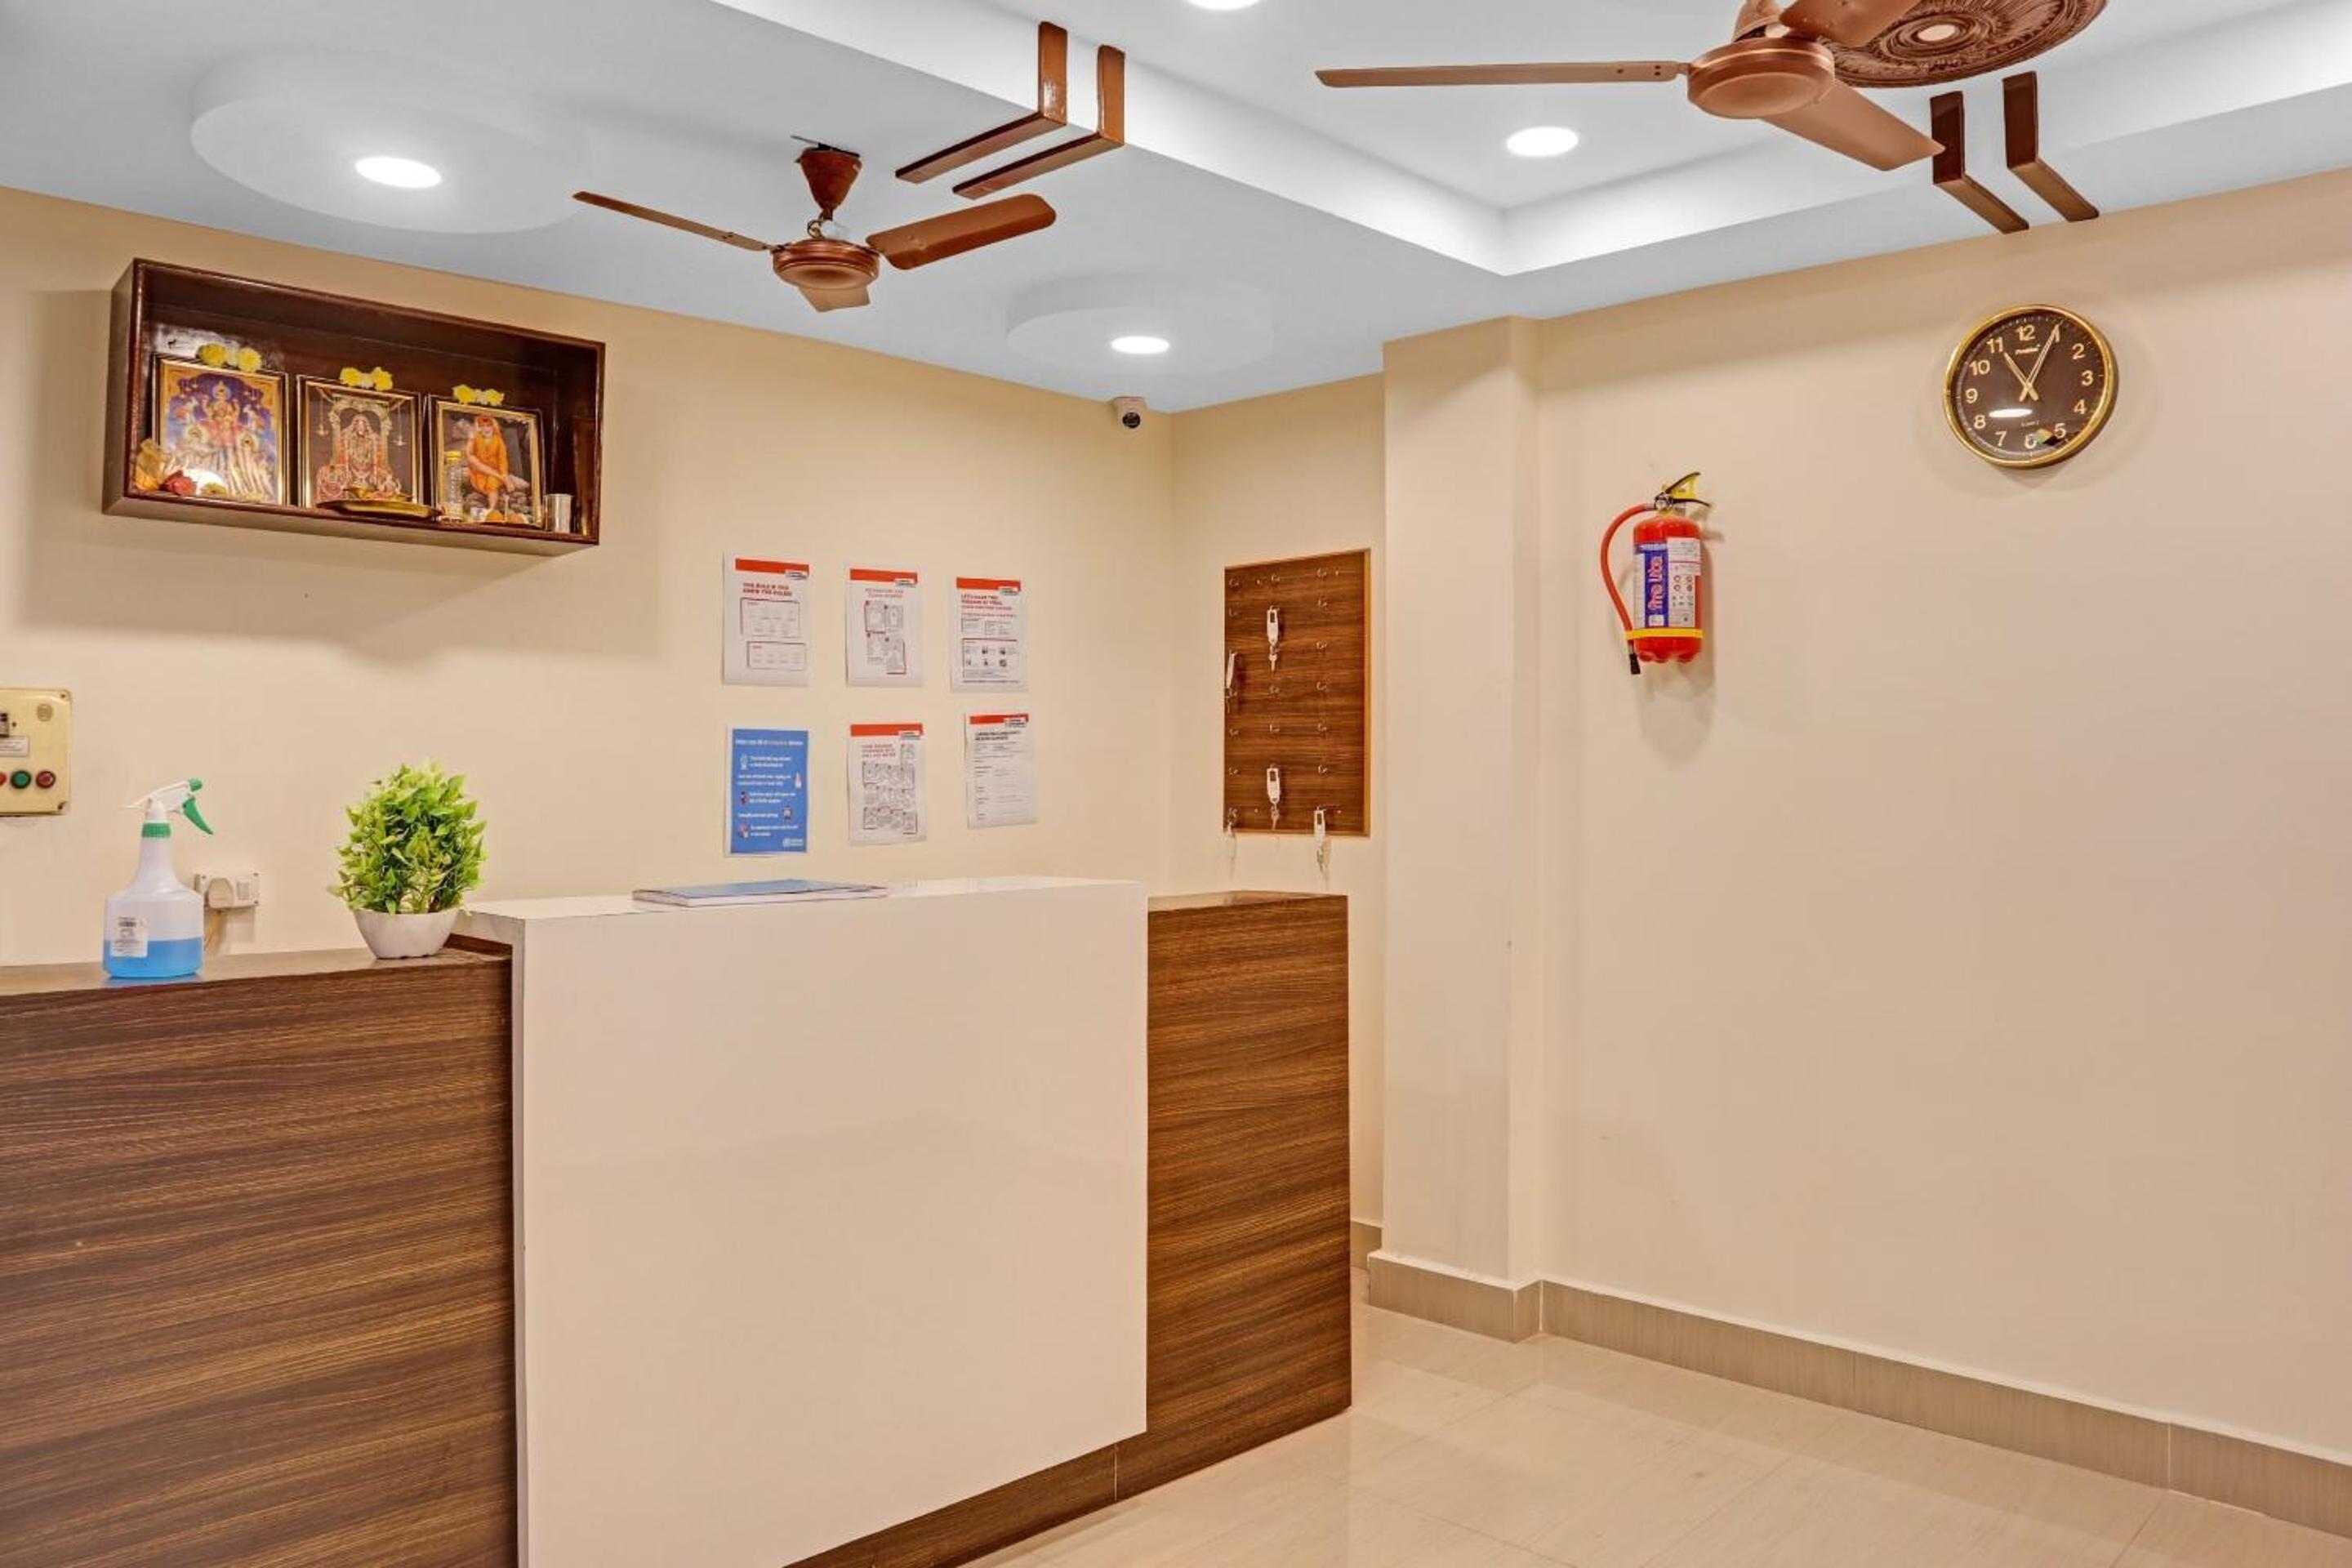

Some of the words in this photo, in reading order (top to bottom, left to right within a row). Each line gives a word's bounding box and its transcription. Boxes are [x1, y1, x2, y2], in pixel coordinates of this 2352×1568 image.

[2015, 324, 2036, 341] 12
[1986, 336, 2003, 354] 11
[2072, 343, 2086, 359] 2
[1969, 359, 1990, 376] 10
[2082, 370, 2094, 386] 3
[1965, 388, 1978, 404] 9
[2074, 399, 2086, 414] 4
[1974, 414, 1986, 430] 8
[1995, 430, 2007, 447] 7
[2053, 422, 2066, 439] 5
[2024, 434, 2037, 449] 6
